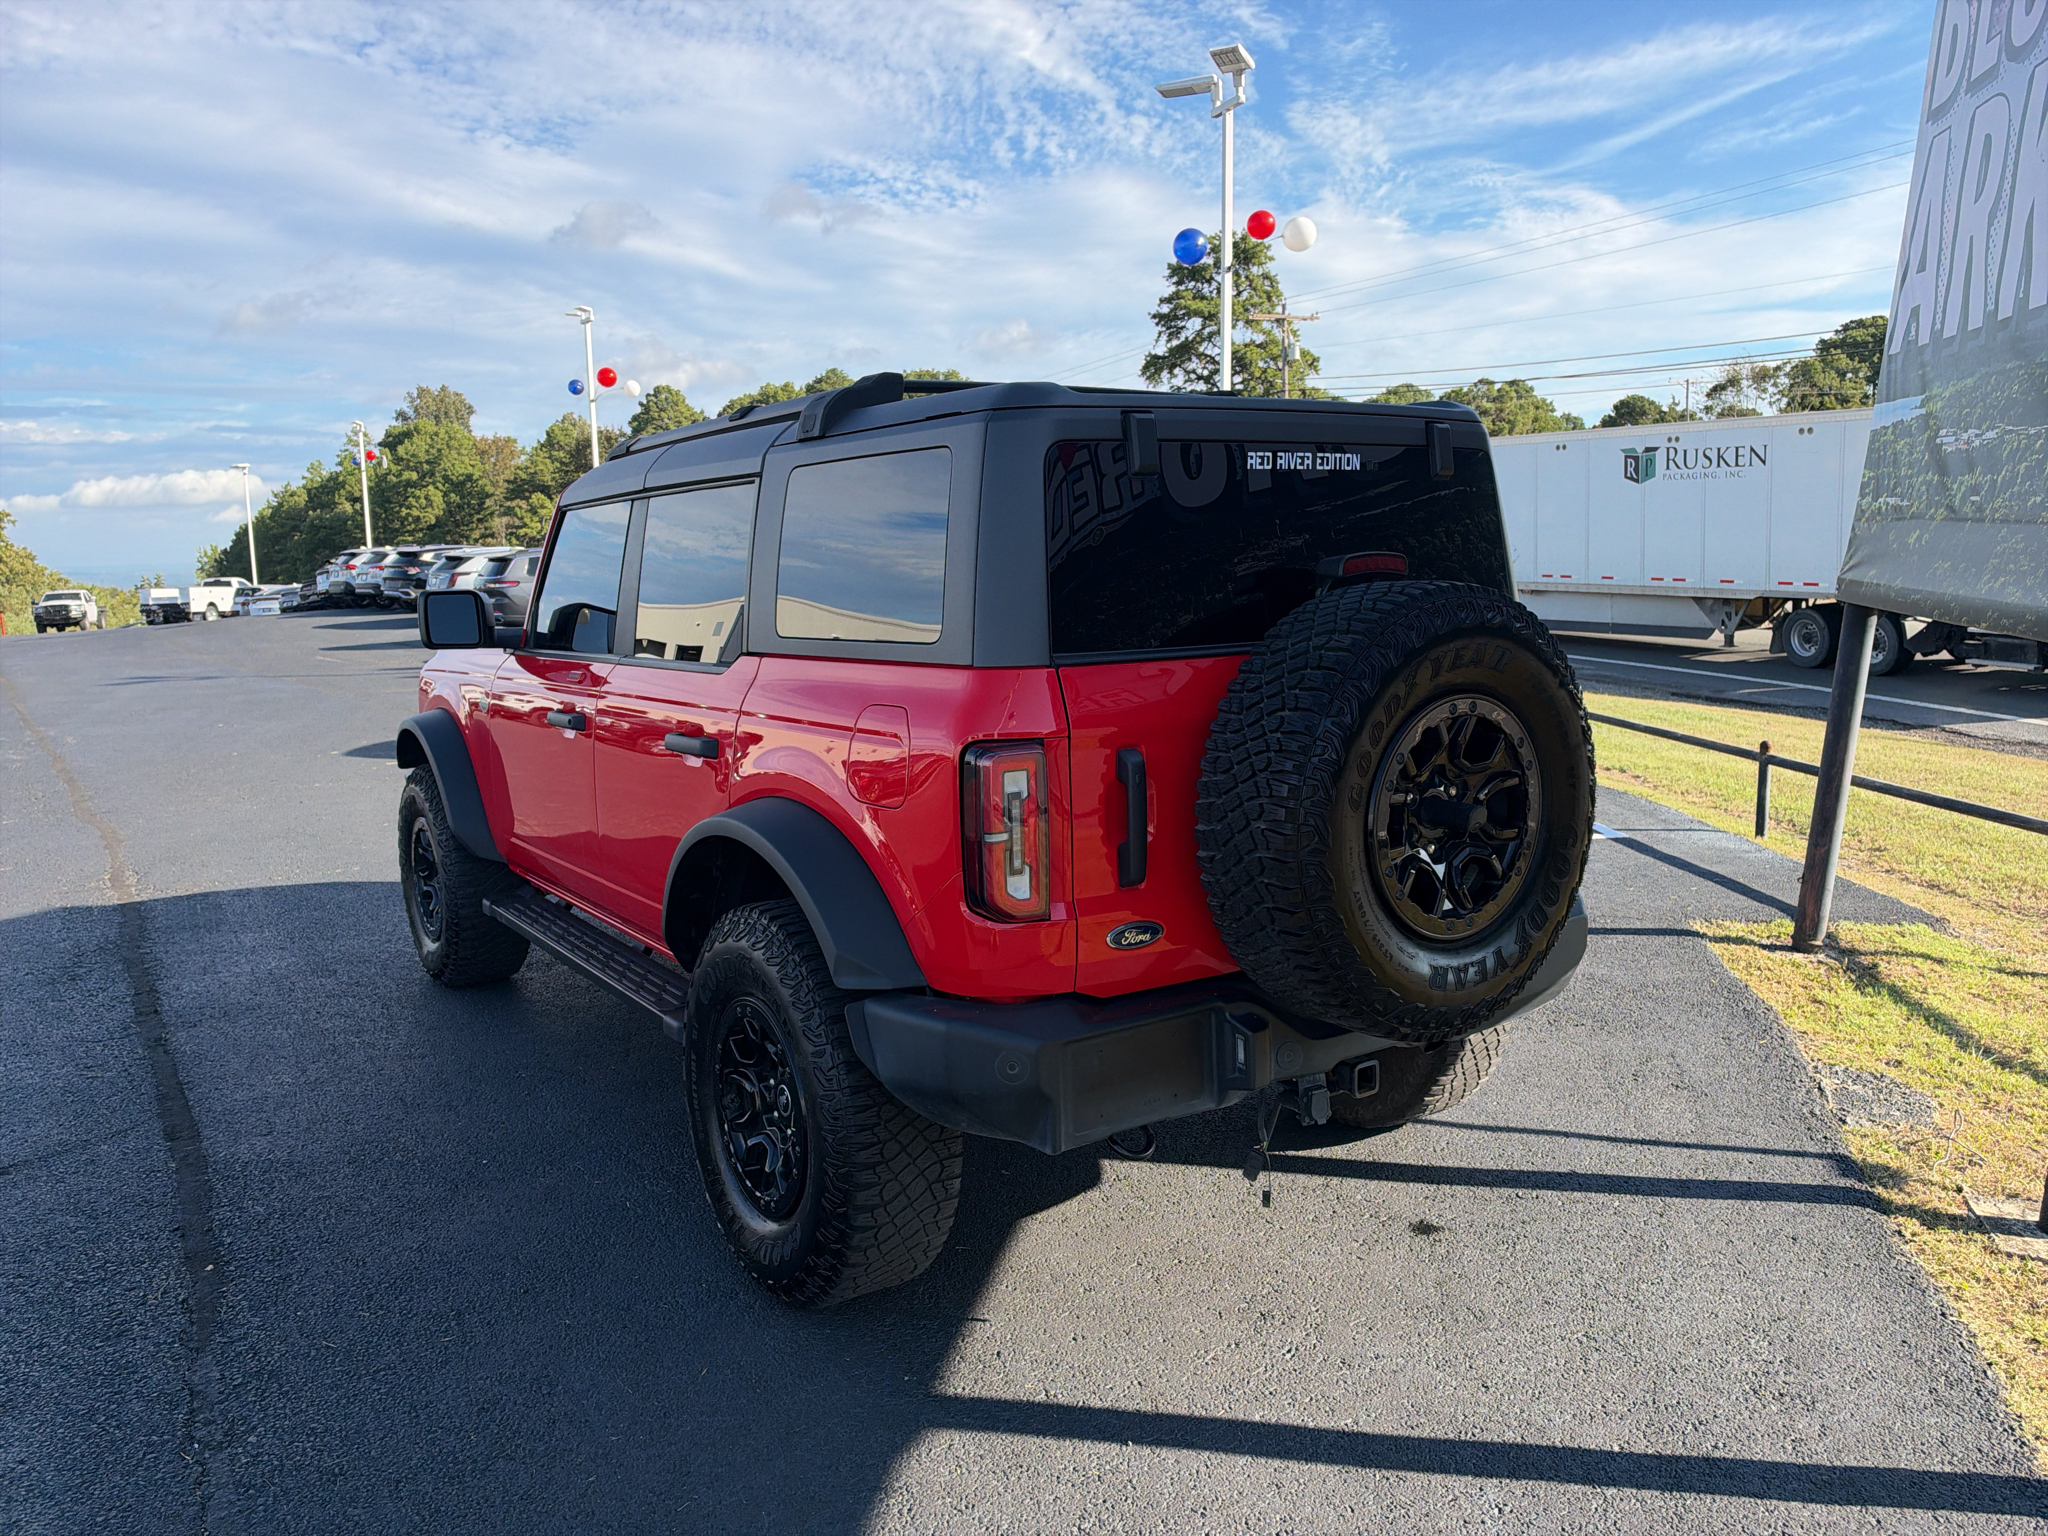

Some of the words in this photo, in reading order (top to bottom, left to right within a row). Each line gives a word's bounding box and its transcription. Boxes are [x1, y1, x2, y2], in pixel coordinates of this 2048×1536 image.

[1247, 452, 1272, 470] RED
[1277, 452, 1312, 470] RIVER
[1316, 453, 1361, 471] EDITION
[1664, 444, 1768, 471] RUSKEN
[1724, 469, 1746, 479] INC.
[1121, 928, 1152, 945] Ford
